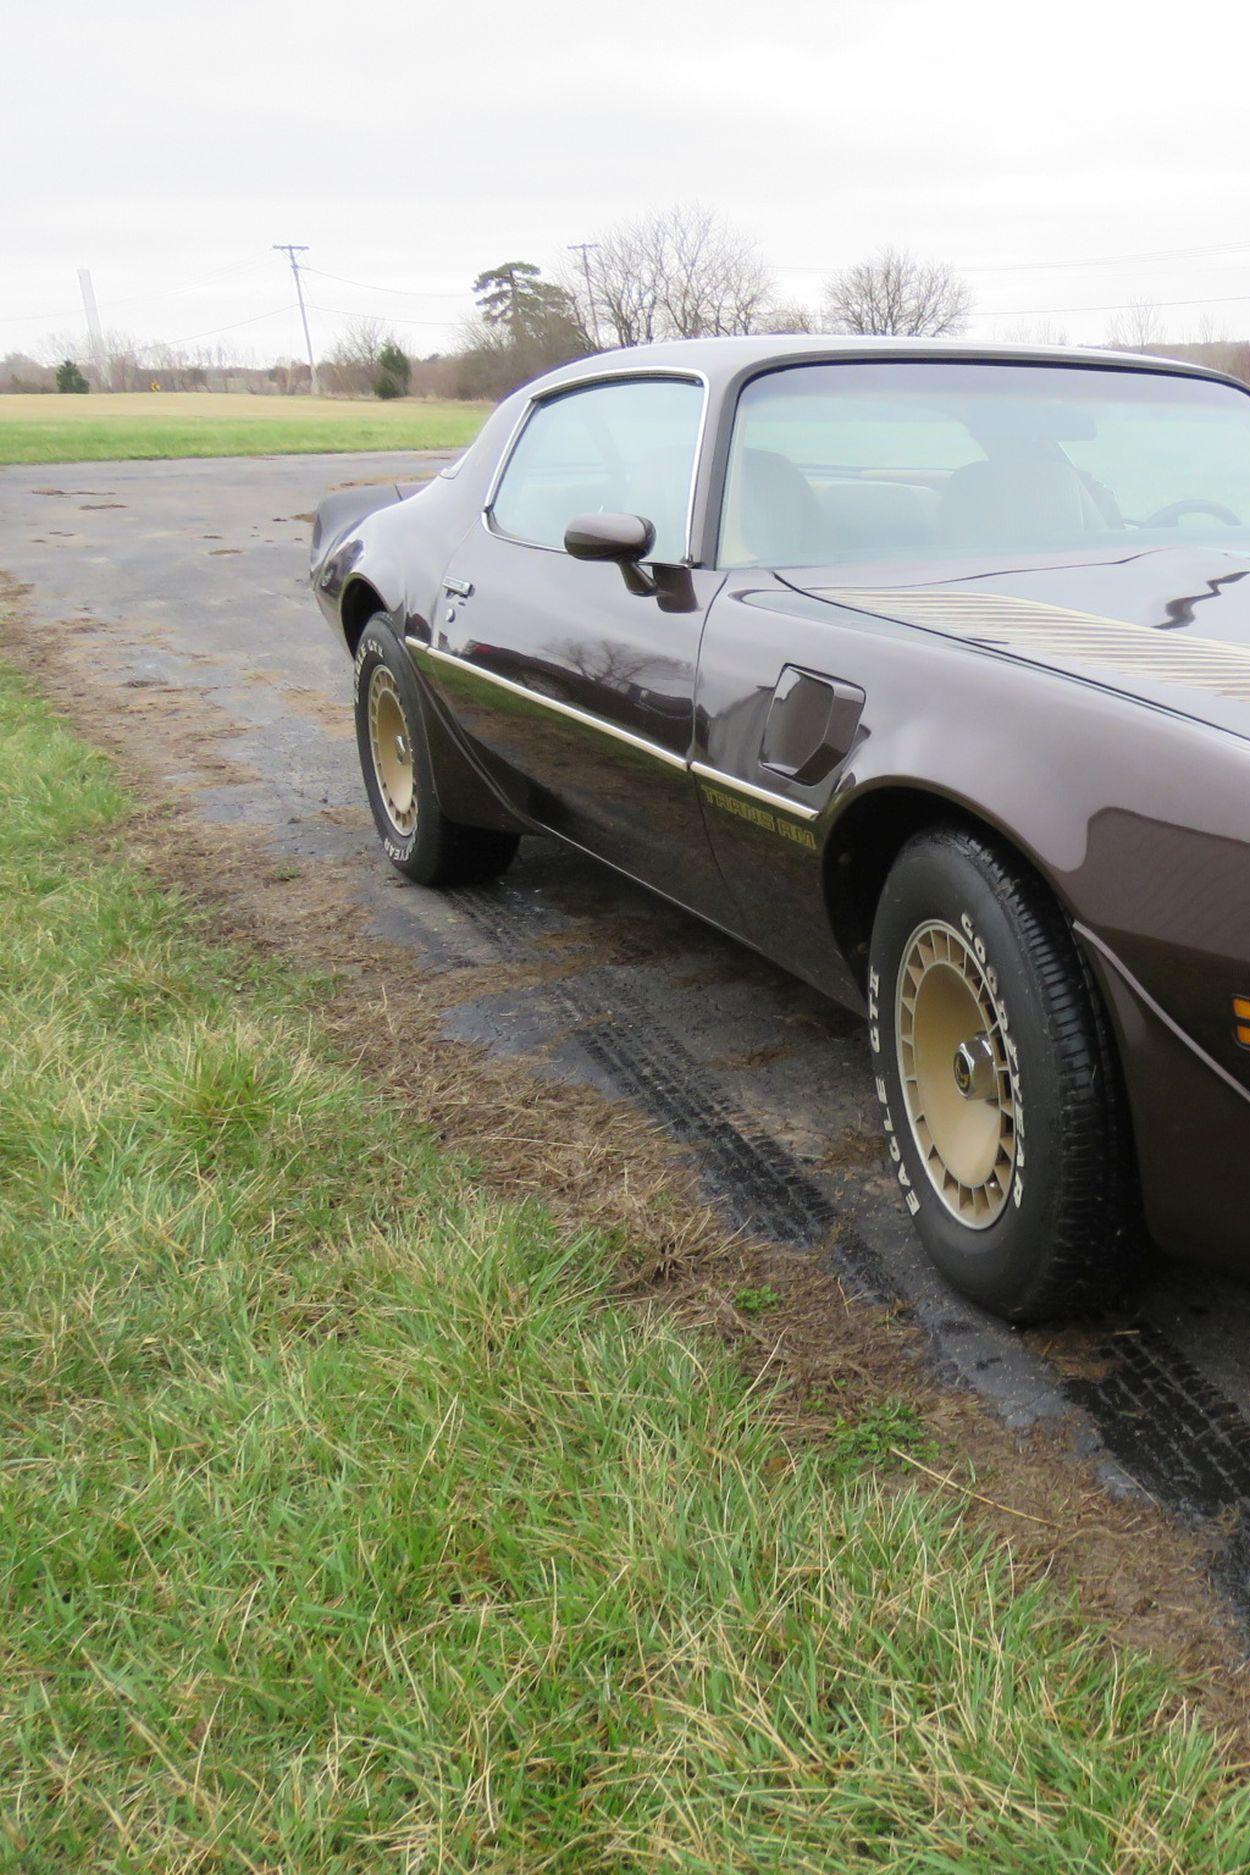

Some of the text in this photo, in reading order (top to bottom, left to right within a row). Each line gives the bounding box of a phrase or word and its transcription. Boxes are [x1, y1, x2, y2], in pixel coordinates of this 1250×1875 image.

[701, 784, 817, 850] TRANS AM
[961, 912, 1025, 1209] GOODYEAR
[875, 1076, 921, 1216] EAGLE
